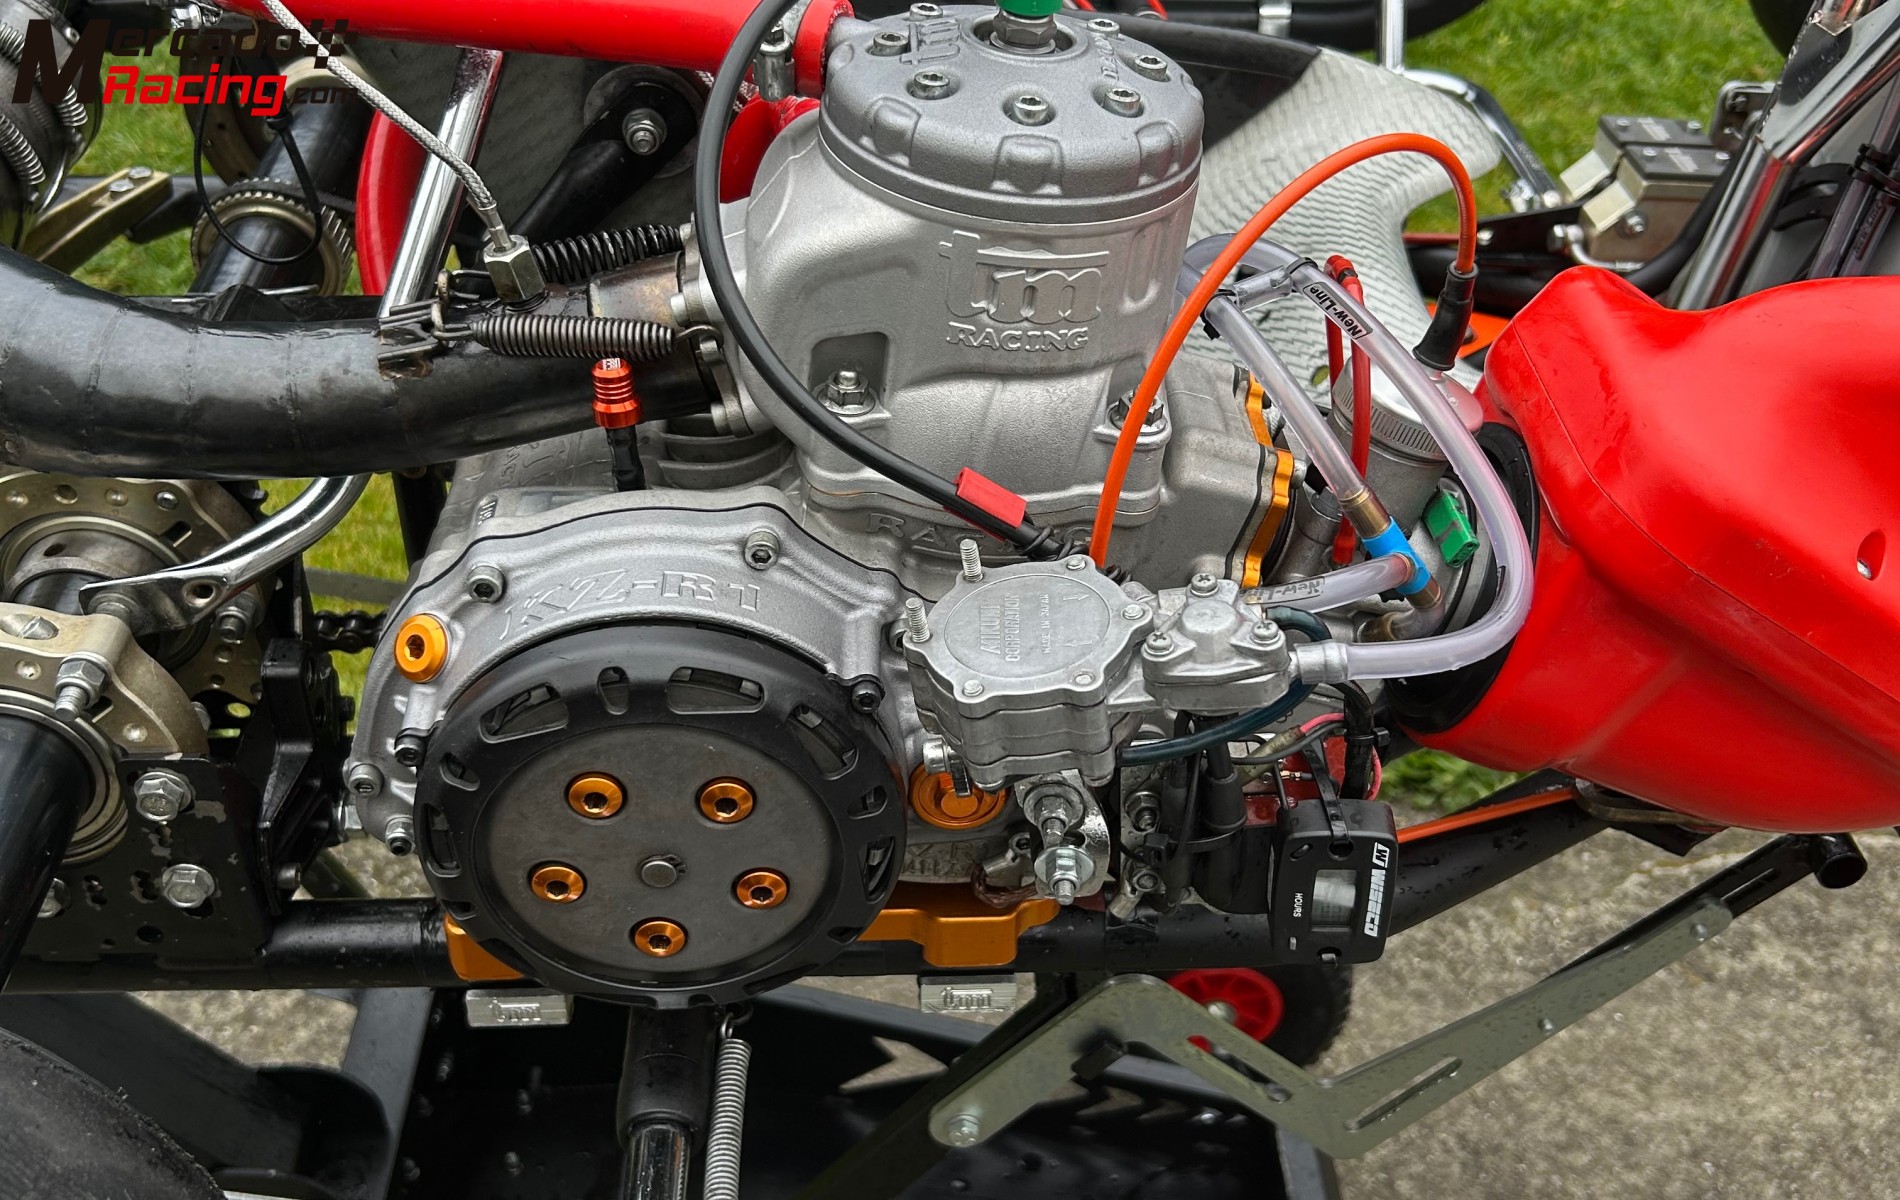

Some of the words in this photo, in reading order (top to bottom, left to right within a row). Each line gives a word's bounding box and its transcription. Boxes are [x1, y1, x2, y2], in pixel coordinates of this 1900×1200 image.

[1310, 286, 1362, 337] New-Line
[946, 321, 1089, 352] RACING
[1040, 593, 1050, 617] JAPAN
[1004, 592, 1021, 662] CORPORATION
[1040, 620, 1051, 629] IN
[1041, 633, 1051, 655] MADE
[1293, 892, 1304, 918] HOURS
[1364, 868, 1386, 937] WISECO
